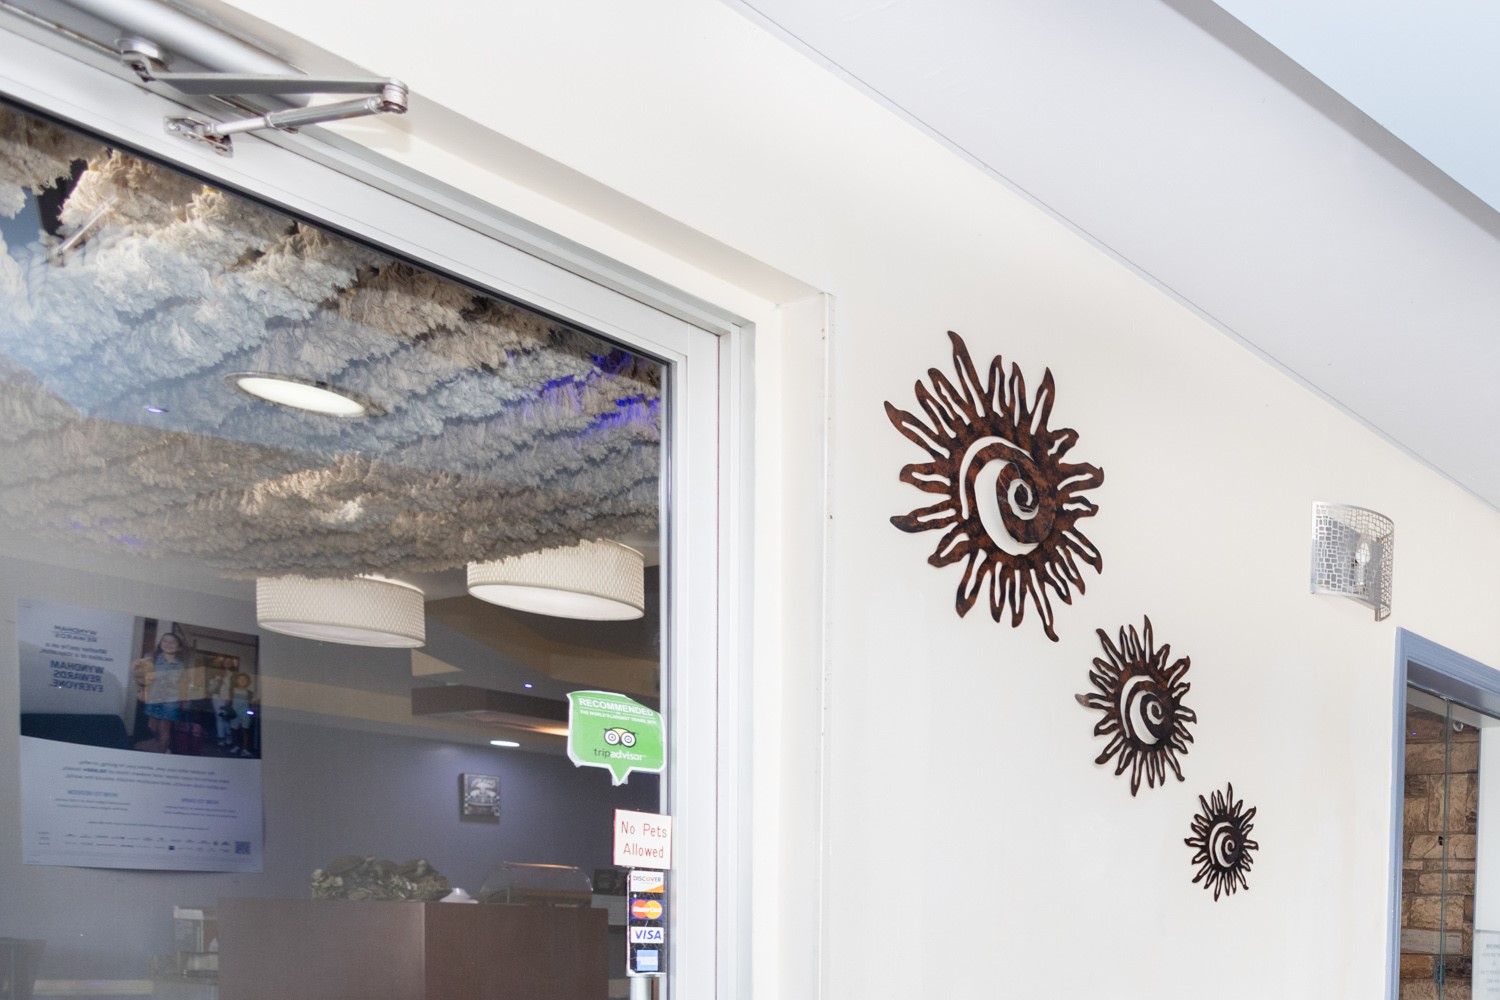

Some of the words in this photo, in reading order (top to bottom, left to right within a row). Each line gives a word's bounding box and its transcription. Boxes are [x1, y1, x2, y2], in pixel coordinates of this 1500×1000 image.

[578, 698, 654, 717] RECOMMENDED
[594, 748, 643, 761] tripadvisor
[621, 820, 636, 836] No
[643, 823, 668, 838] Pets
[623, 842, 664, 859] Allowed
[633, 875, 662, 883] DISCOVER
[635, 929, 662, 940] VISA
